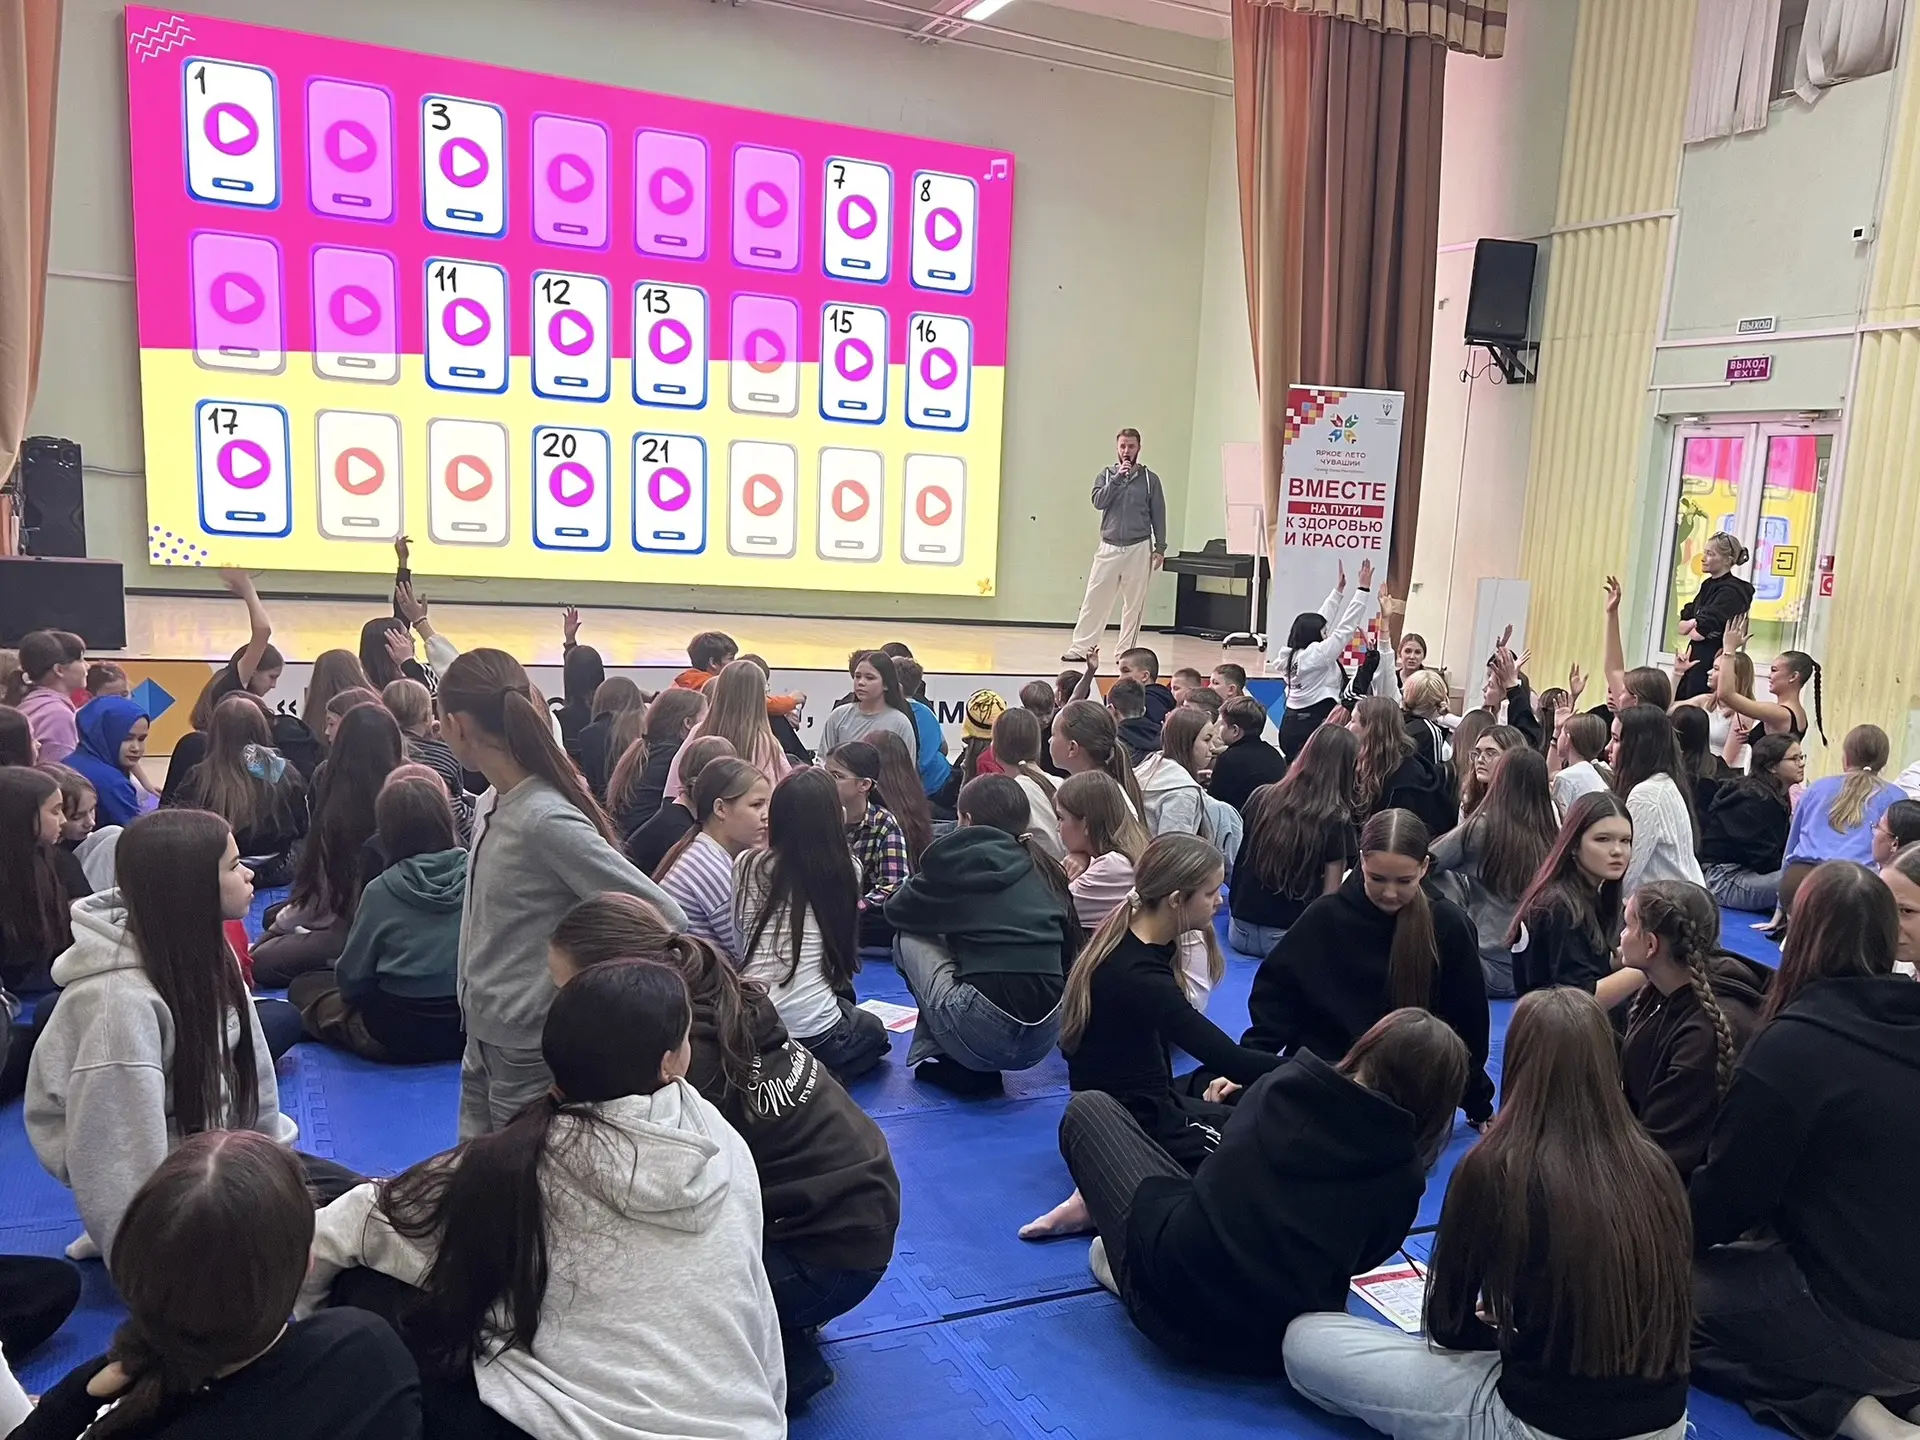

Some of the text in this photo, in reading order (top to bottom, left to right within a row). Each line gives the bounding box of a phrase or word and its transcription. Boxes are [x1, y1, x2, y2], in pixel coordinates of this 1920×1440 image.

[194, 66, 206, 95] 1
[431, 103, 451, 131] 3
[832, 164, 846, 190] 7
[920, 179, 931, 202] 8
[434, 265, 457, 293] 11
[541, 278, 571, 306] 12
[642, 288, 671, 314] 13
[829, 309, 855, 334] 15
[916, 319, 937, 343] 16
[1740, 320, 1771, 331] ВЫХОД
[1730, 359, 1766, 370] ВЫХОД
[1734, 369, 1761, 378] EXIT
[208, 407, 239, 435] 17
[542, 432, 577, 459] 20
[642, 438, 669, 464] 21
[1315, 450, 1367, 459] ЯРКОЕ ЛЕТО
[1320, 458, 1361, 467] ЧУВАШИИ
[1288, 477, 1387, 501] ВМЕСТЕ
[1310, 504, 1362, 516] НА ПУТИ
[1285, 516, 1383, 533] К ЗДОРОВЬЮ
[1284, 532, 1382, 550] И КРАСОТЕ
